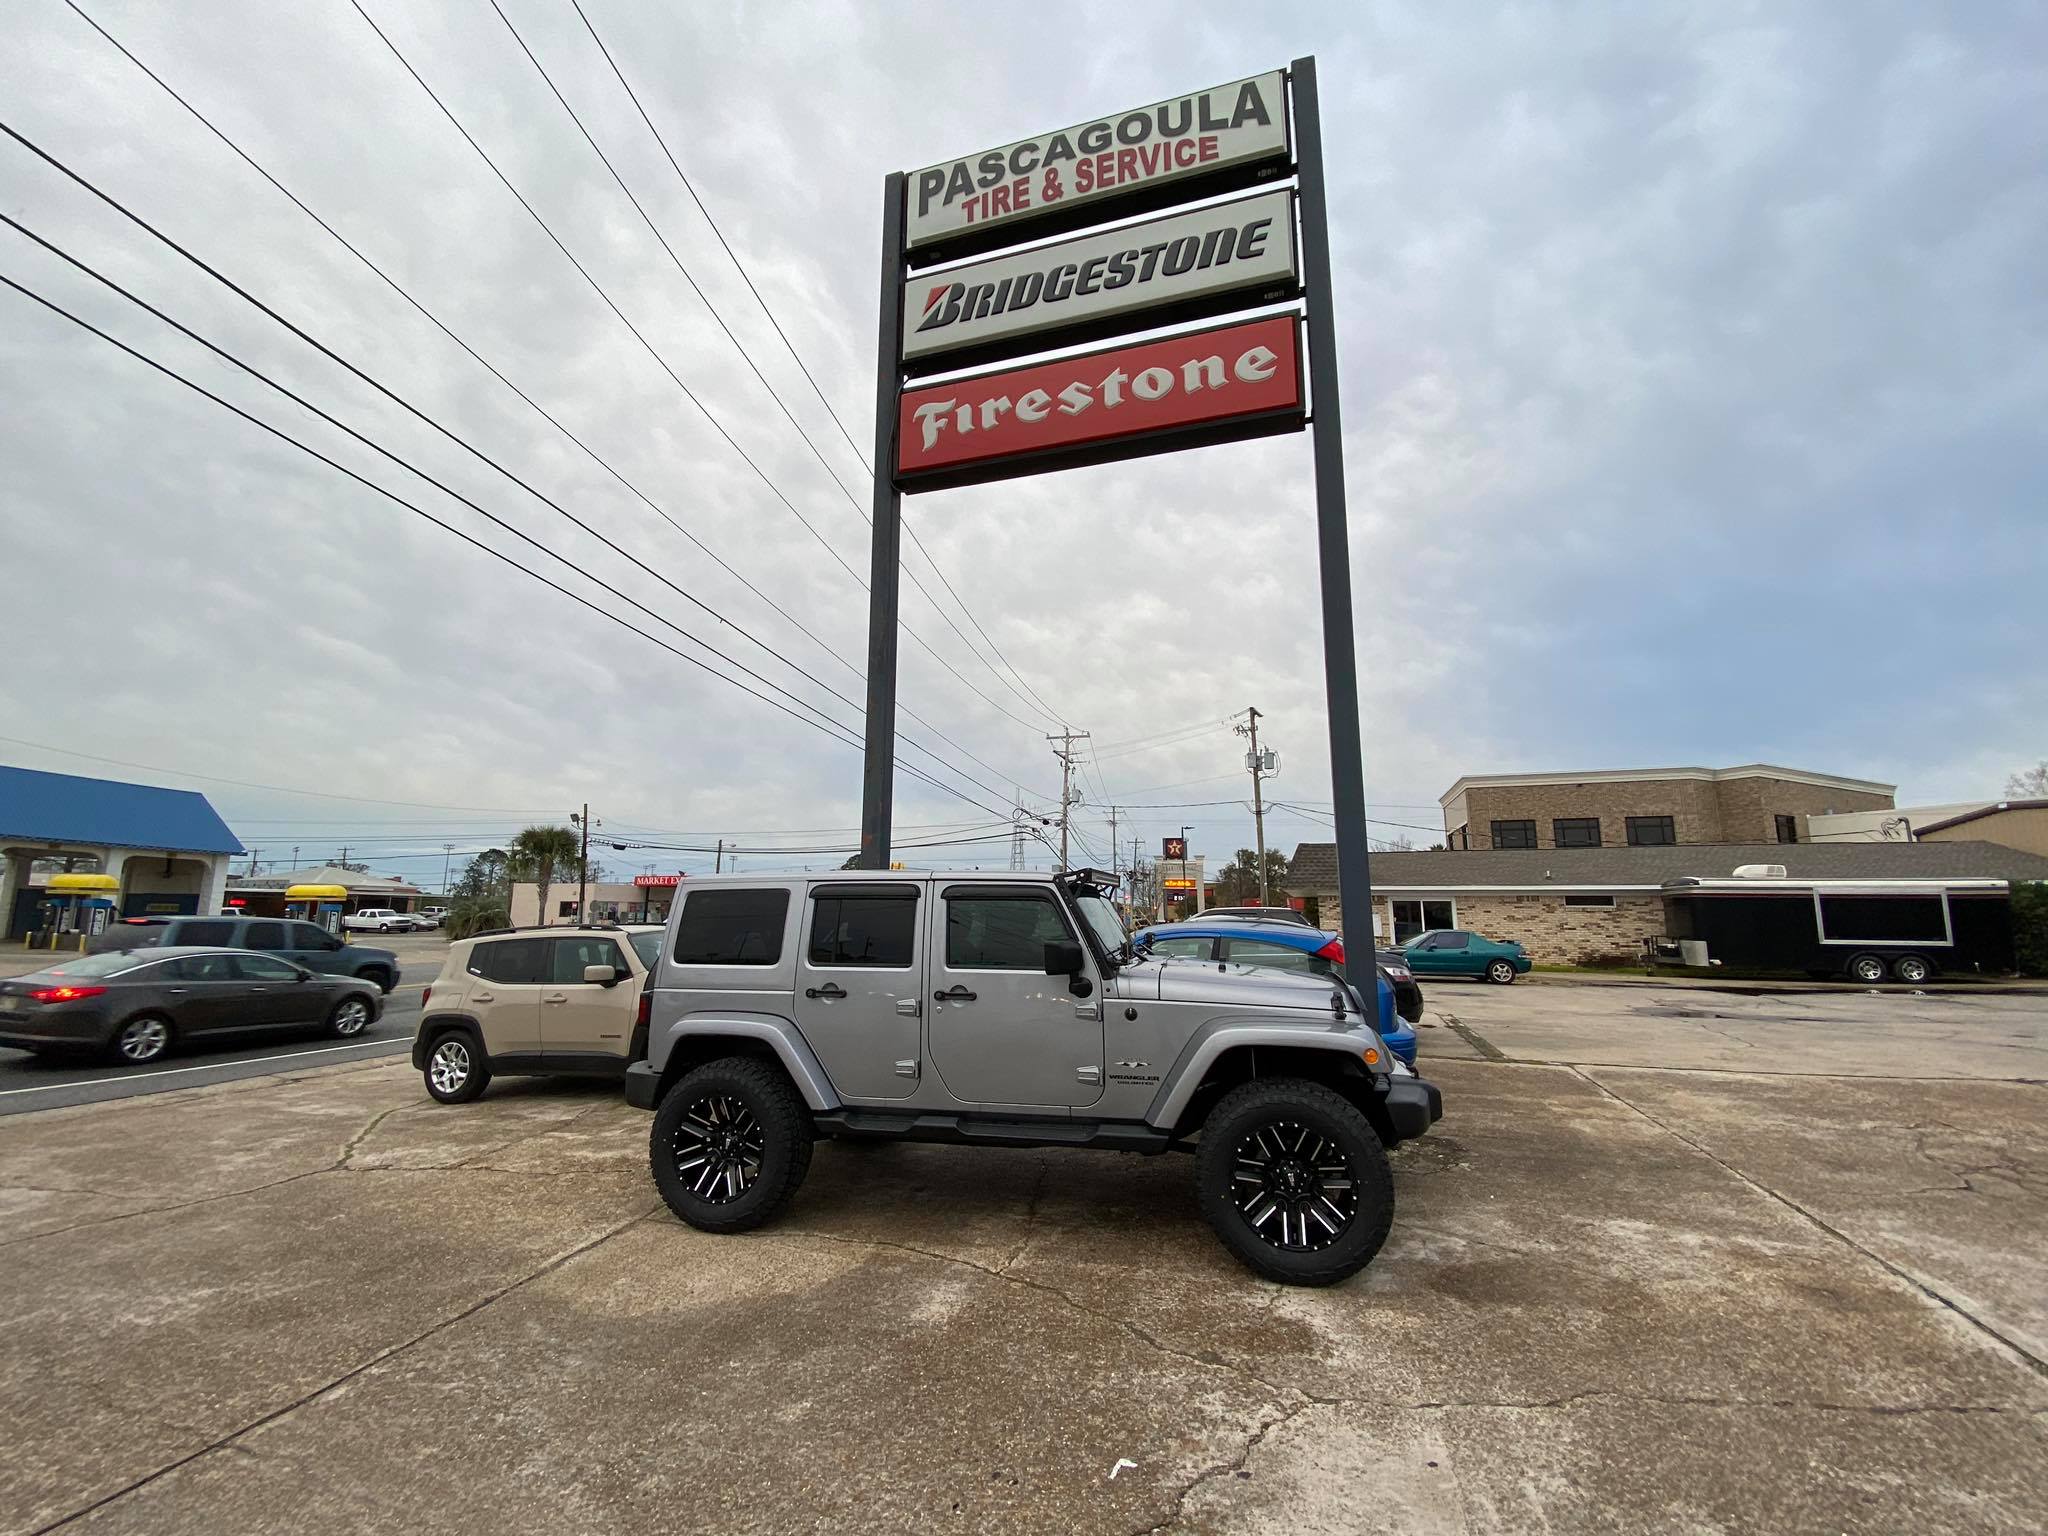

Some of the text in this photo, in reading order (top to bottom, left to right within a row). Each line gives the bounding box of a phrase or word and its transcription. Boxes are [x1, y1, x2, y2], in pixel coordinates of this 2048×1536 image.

[918, 80, 1272, 218] PASCAGOULA
[961, 135, 1220, 223] TIRE & SERVICE
[914, 217, 1273, 333] BRIDGESTONE
[912, 345, 1279, 453] Firestone
[636, 876, 670, 885] MARKET
[1109, 1074, 1160, 1082] WRANGLER
